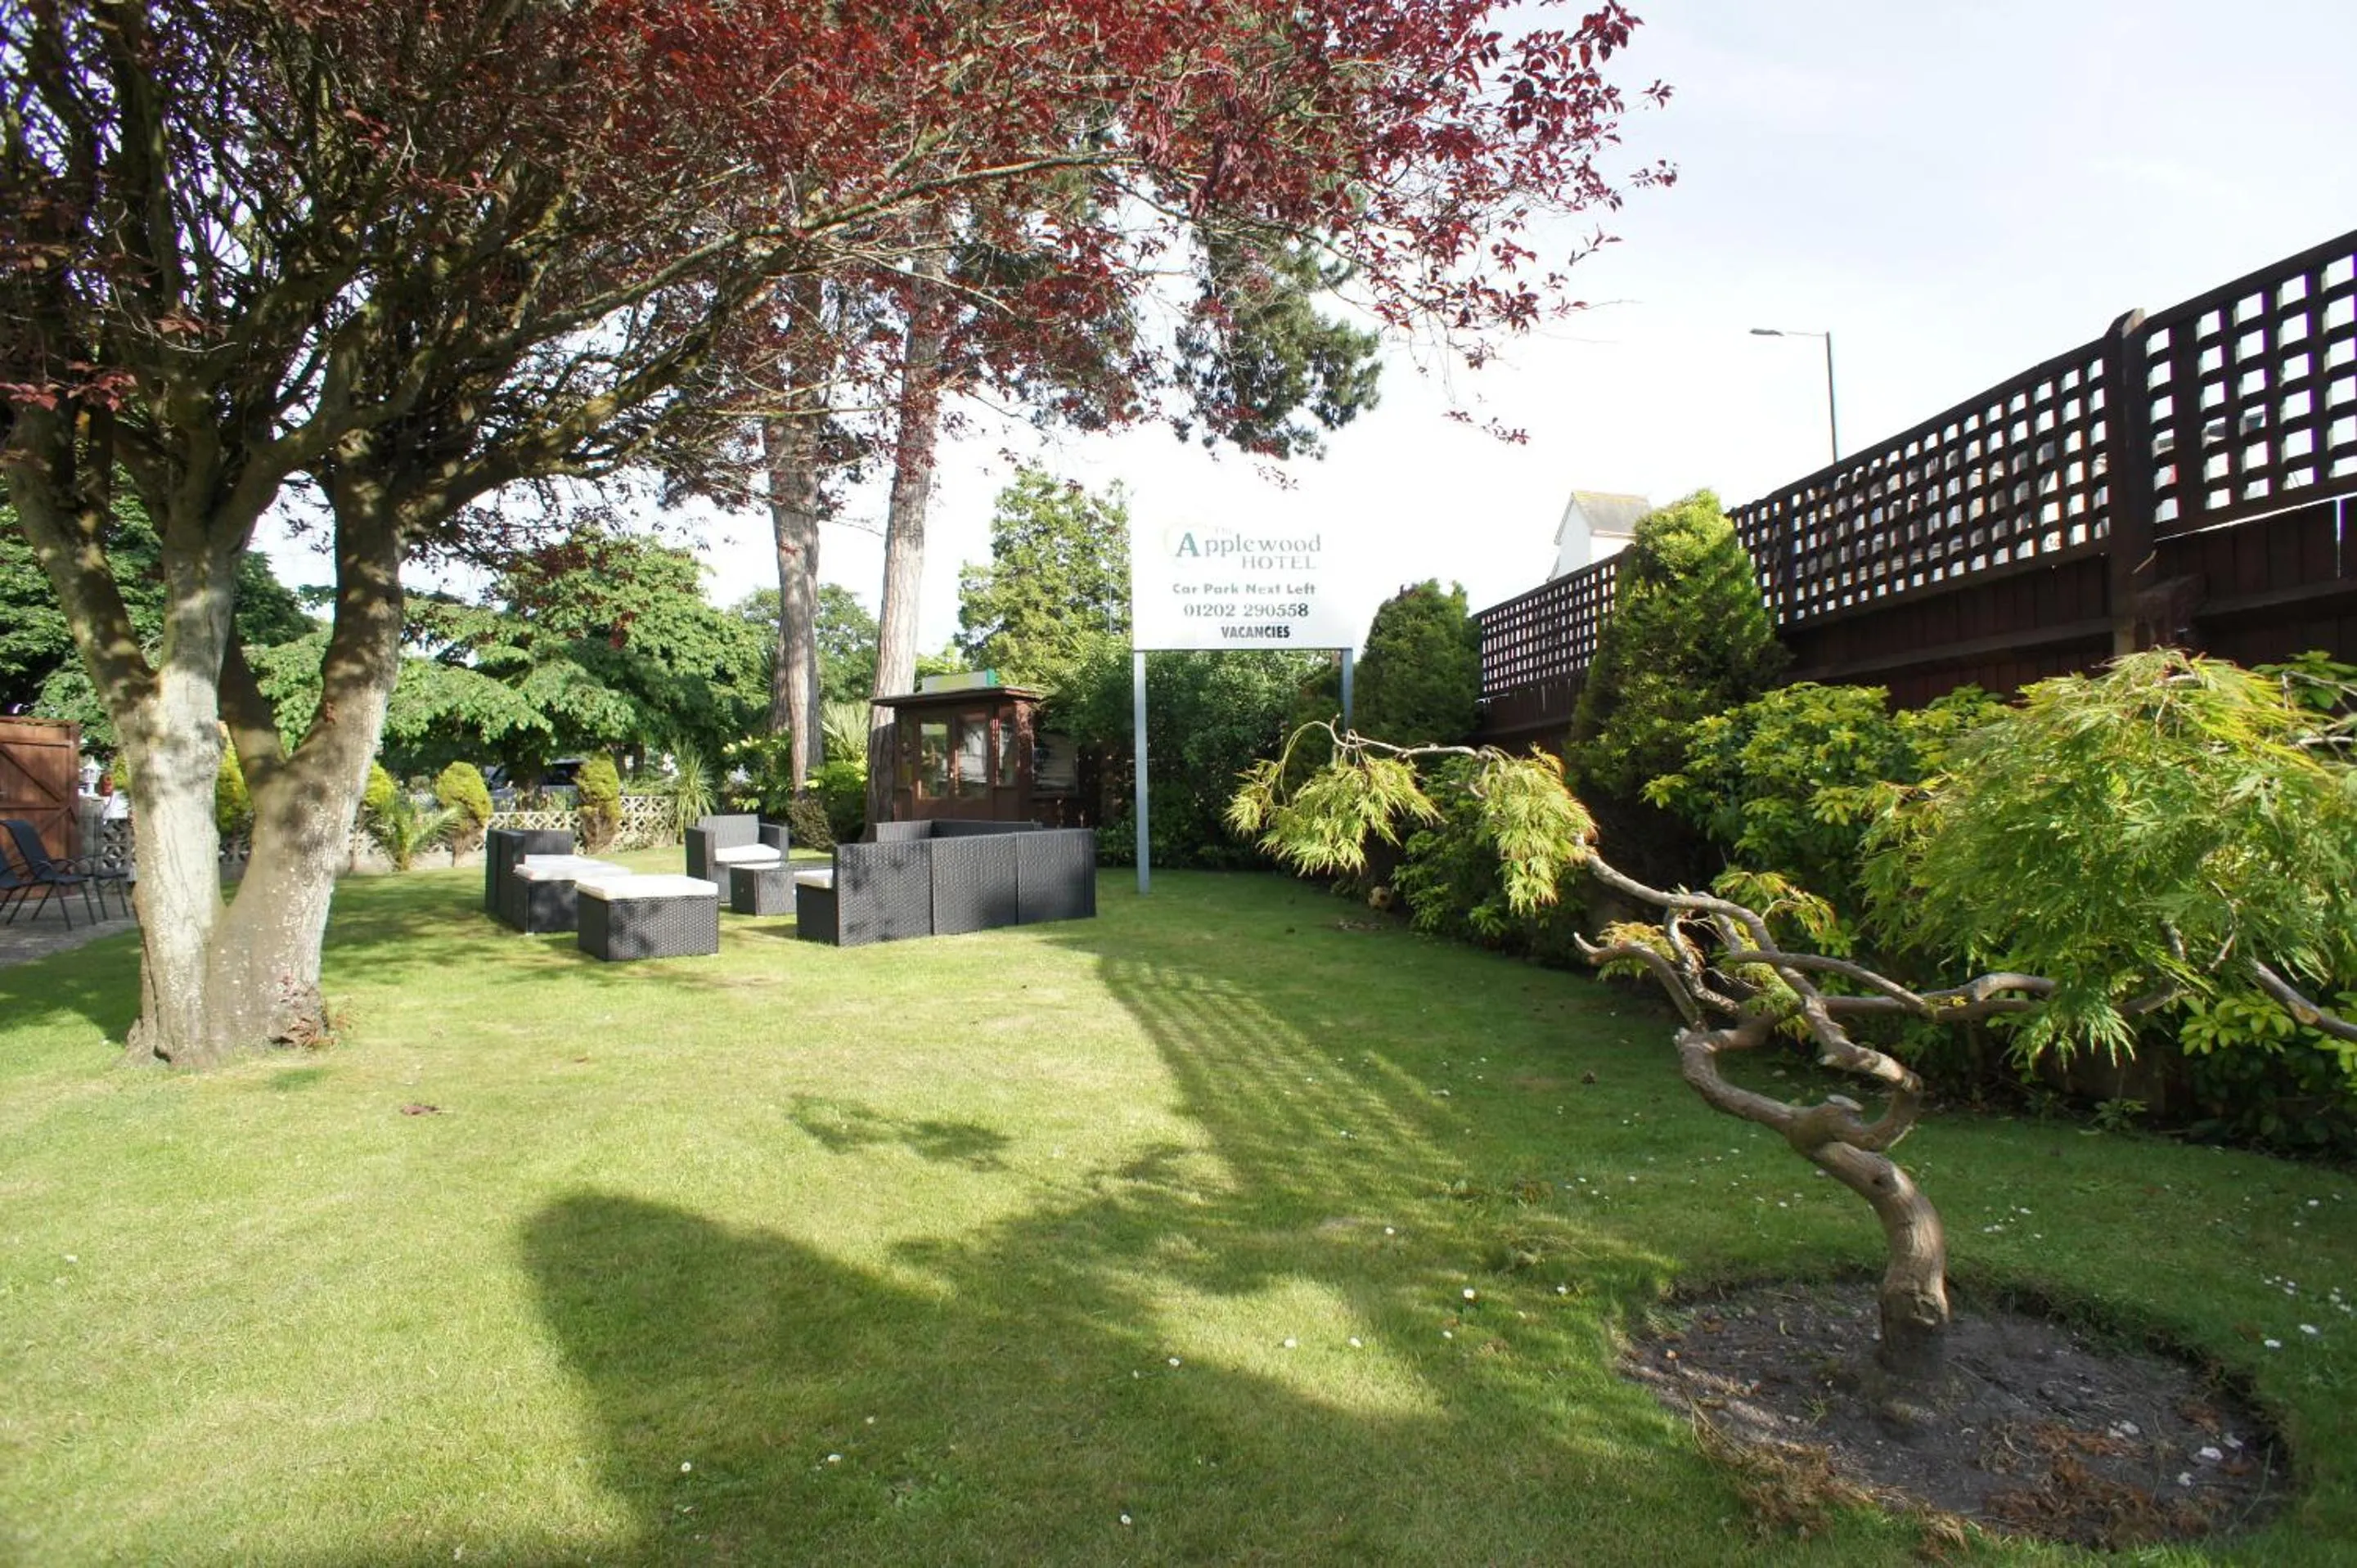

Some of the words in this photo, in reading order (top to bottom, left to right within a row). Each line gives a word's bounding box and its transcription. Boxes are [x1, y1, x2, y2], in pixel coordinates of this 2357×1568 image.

[1175, 532, 1321, 558] Applewood
[1241, 555, 1318, 570] HOTEL
[1172, 582, 1199, 595] Car
[1203, 582, 1239, 595] Park
[1245, 582, 1281, 595] Next
[1285, 582, 1317, 595] Left
[1183, 603, 1236, 618] 01202
[1243, 603, 1309, 618] 290558
[1221, 625, 1291, 640] VACANCIES
